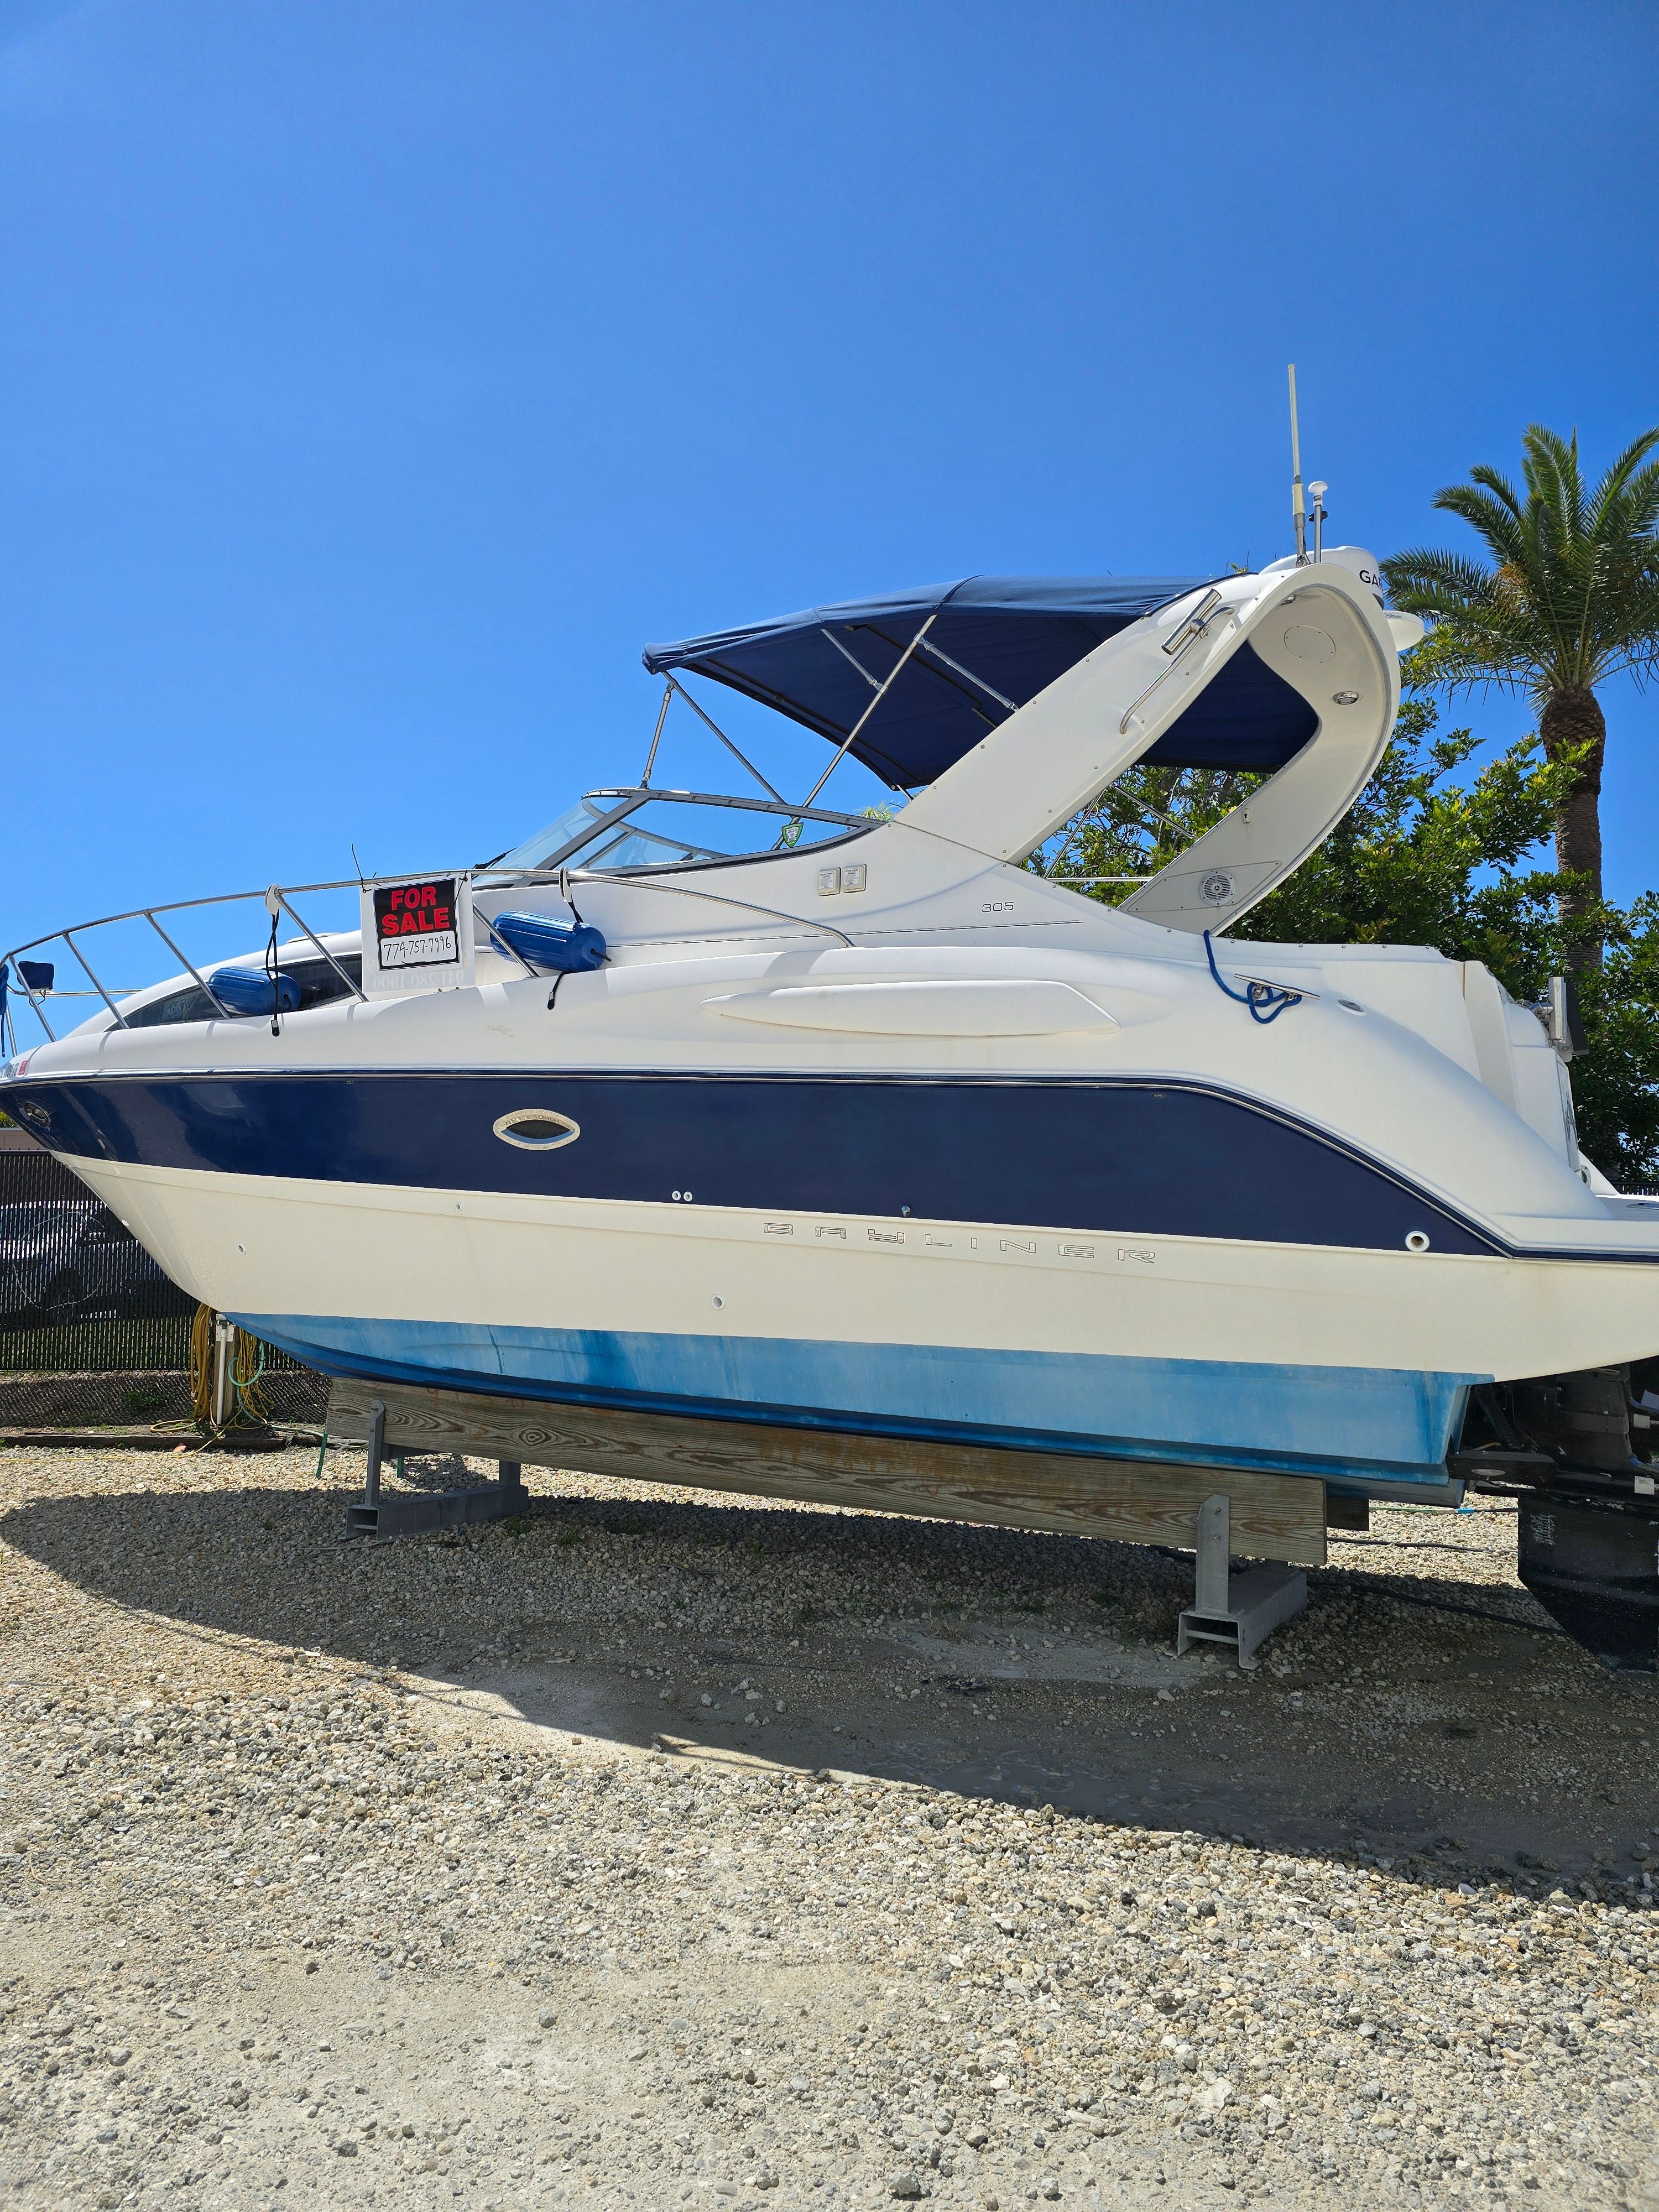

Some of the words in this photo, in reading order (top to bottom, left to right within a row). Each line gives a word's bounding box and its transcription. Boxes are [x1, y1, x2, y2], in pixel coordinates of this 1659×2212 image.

[391, 886, 436, 911] FOR
[982, 901, 1014, 913] 305
[382, 907, 450, 935] SALE
[383, 936, 451, 961] 774-757-7996
[763, 1222, 1155, 1264] BAYLINER
